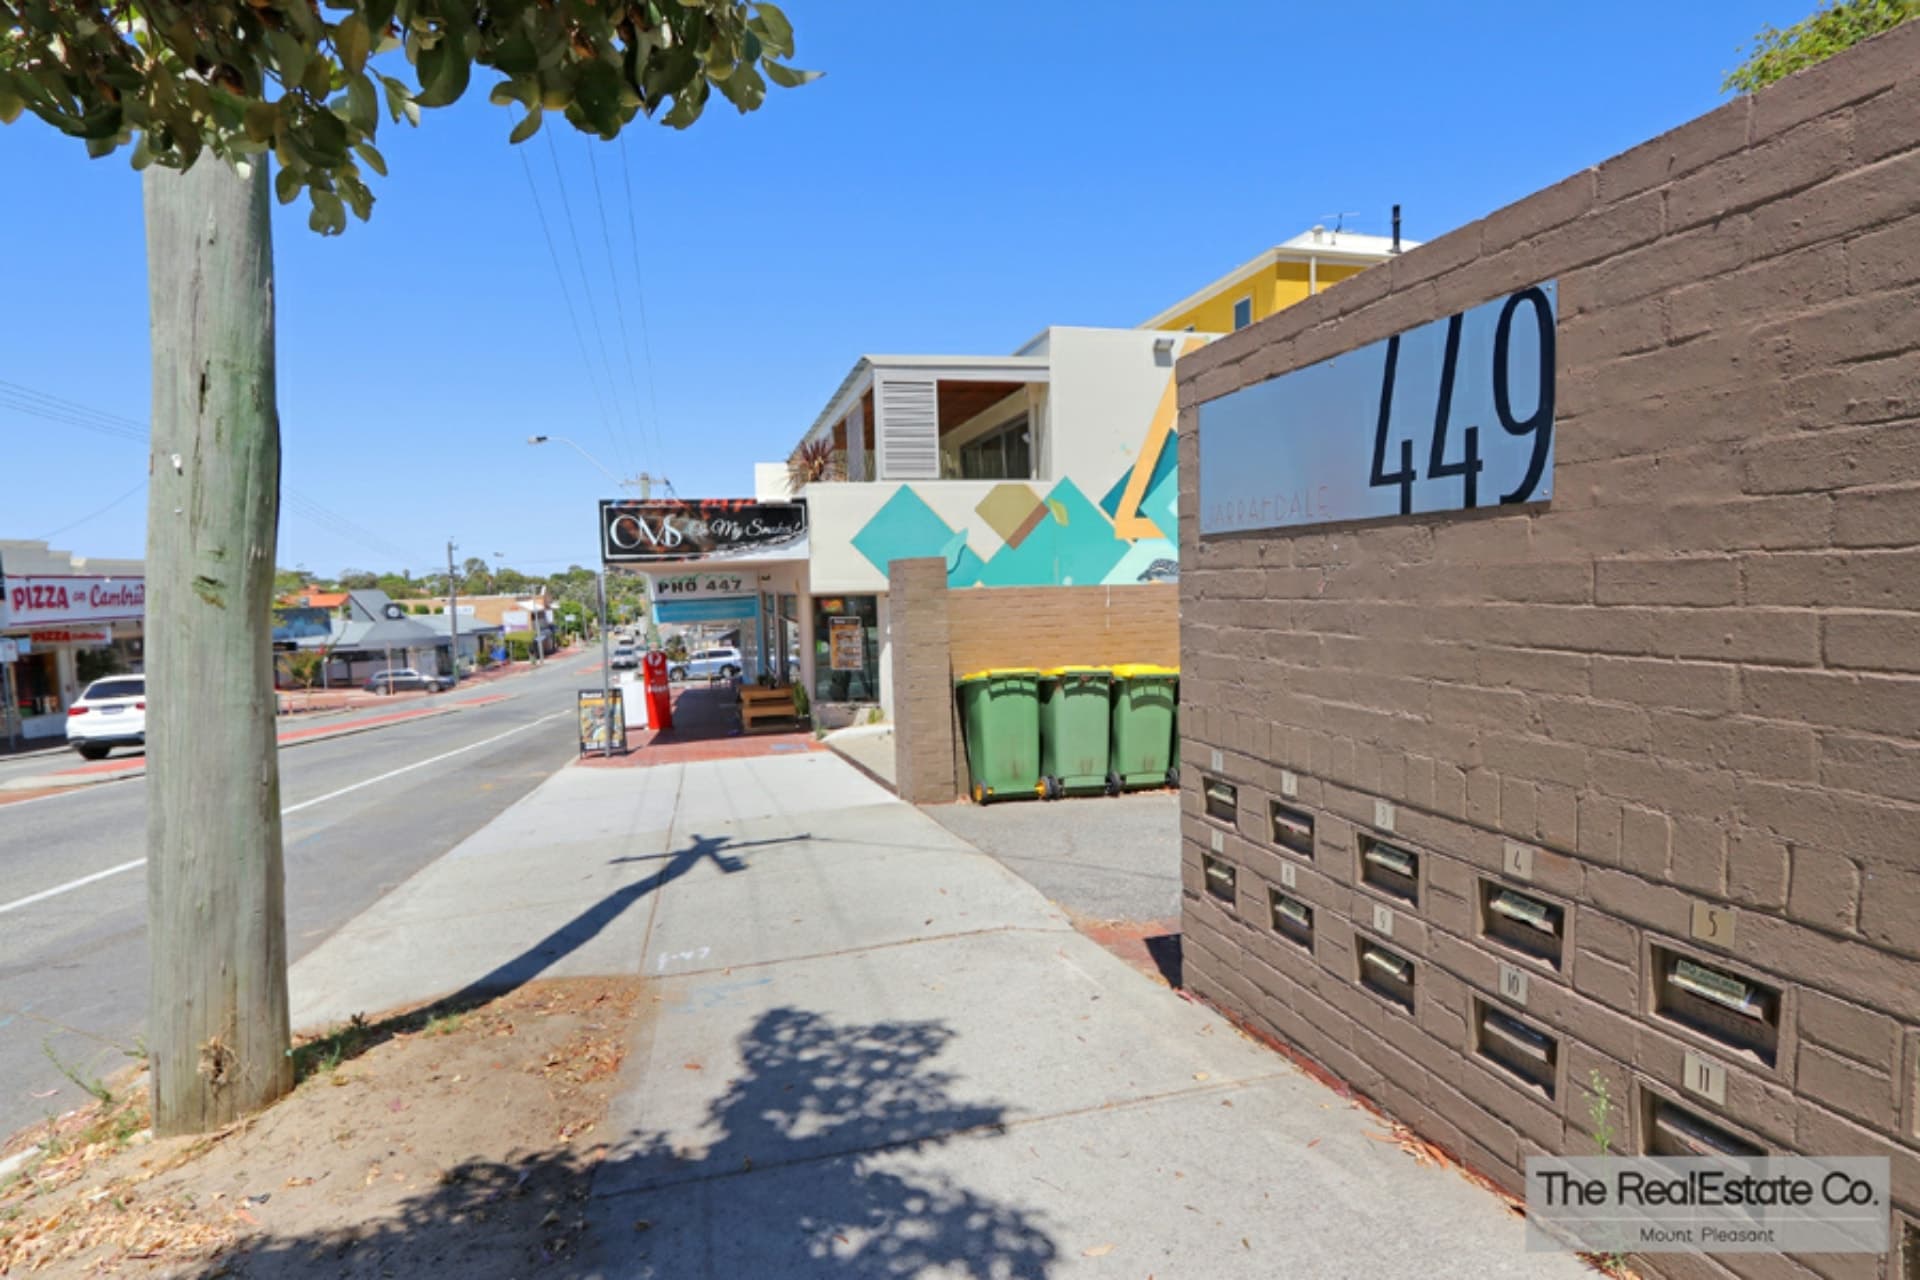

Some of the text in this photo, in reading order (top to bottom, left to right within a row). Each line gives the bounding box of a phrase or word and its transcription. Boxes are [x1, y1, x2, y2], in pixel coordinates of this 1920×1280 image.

[1369, 285, 1556, 515] 449
[12, 584, 69, 611] PIZZA
[1708, 910, 1718, 937] 5
[1507, 972, 1520, 996] 10
[1699, 1064, 1710, 1093] 11
